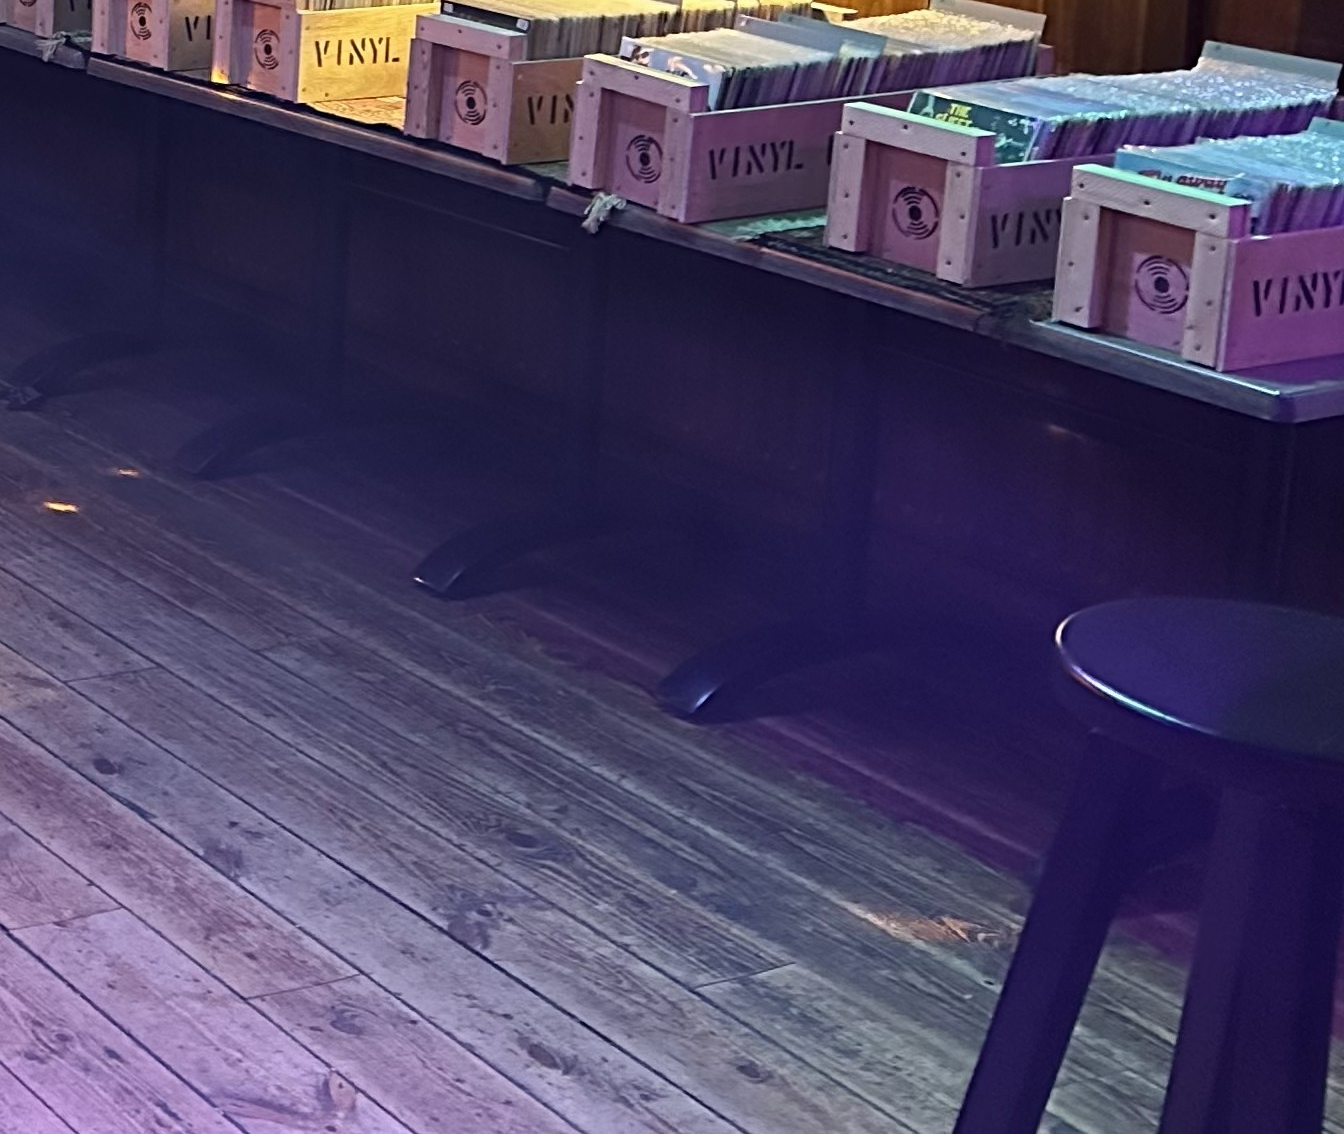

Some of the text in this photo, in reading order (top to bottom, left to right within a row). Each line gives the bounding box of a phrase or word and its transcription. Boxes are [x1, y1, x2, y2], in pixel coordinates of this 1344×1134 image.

[314, 36, 400, 67] VINYL
[526, 93, 574, 125] VIN
[708, 139, 804, 180] VINYL
[990, 209, 1061, 249] VIN
